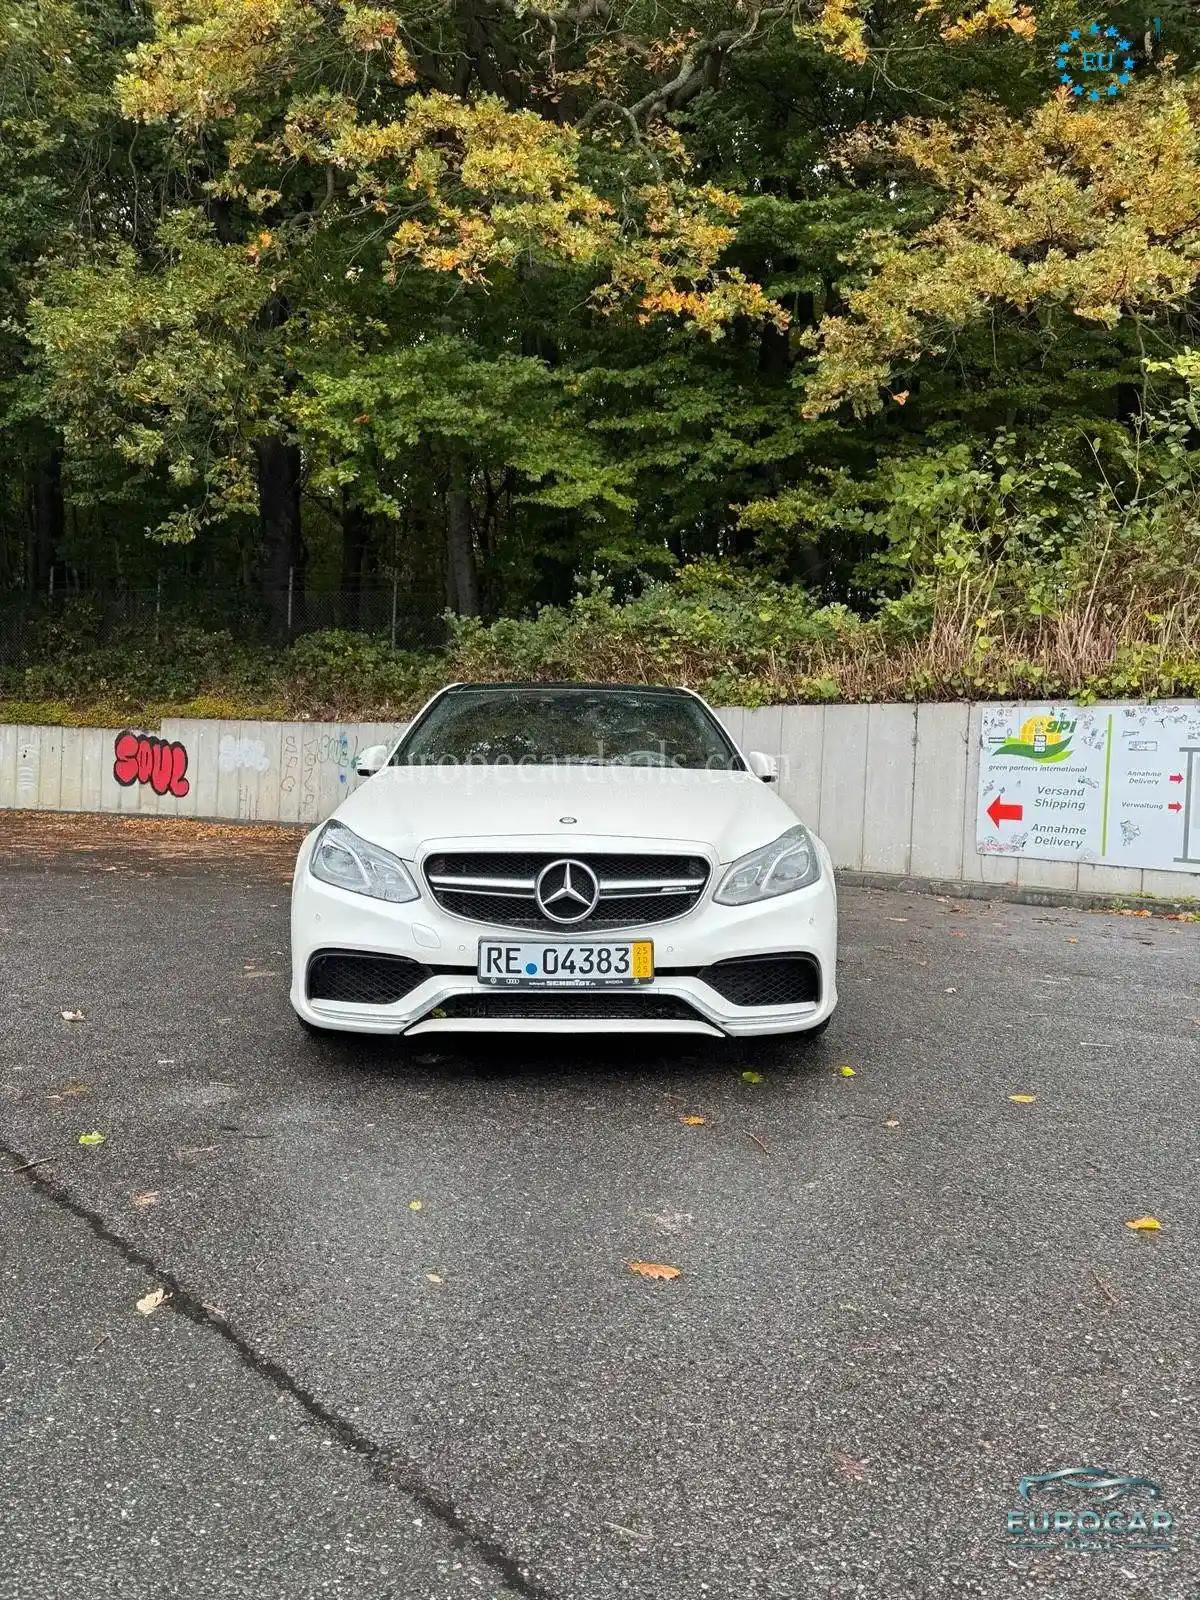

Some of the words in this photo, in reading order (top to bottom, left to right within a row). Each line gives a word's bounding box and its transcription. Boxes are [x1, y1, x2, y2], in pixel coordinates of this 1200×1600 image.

[1045, 717, 1078, 734] gpi
[113, 730, 190, 798] SOUL
[1008, 765, 1038, 773] partners
[1040, 764, 1088, 773] international
[1127, 770, 1162, 778] Annahme
[1128, 777, 1160, 785] Delivery
[1037, 786, 1086, 797] Versand
[1034, 798, 1086, 811] Shipping
[1121, 801, 1164, 810] Verwaltung
[1031, 823, 1087, 835] Annahme
[1034, 835, 1083, 849] Delivery
[486, 947, 522, 973] RE
[542, 947, 630, 975] 04383
